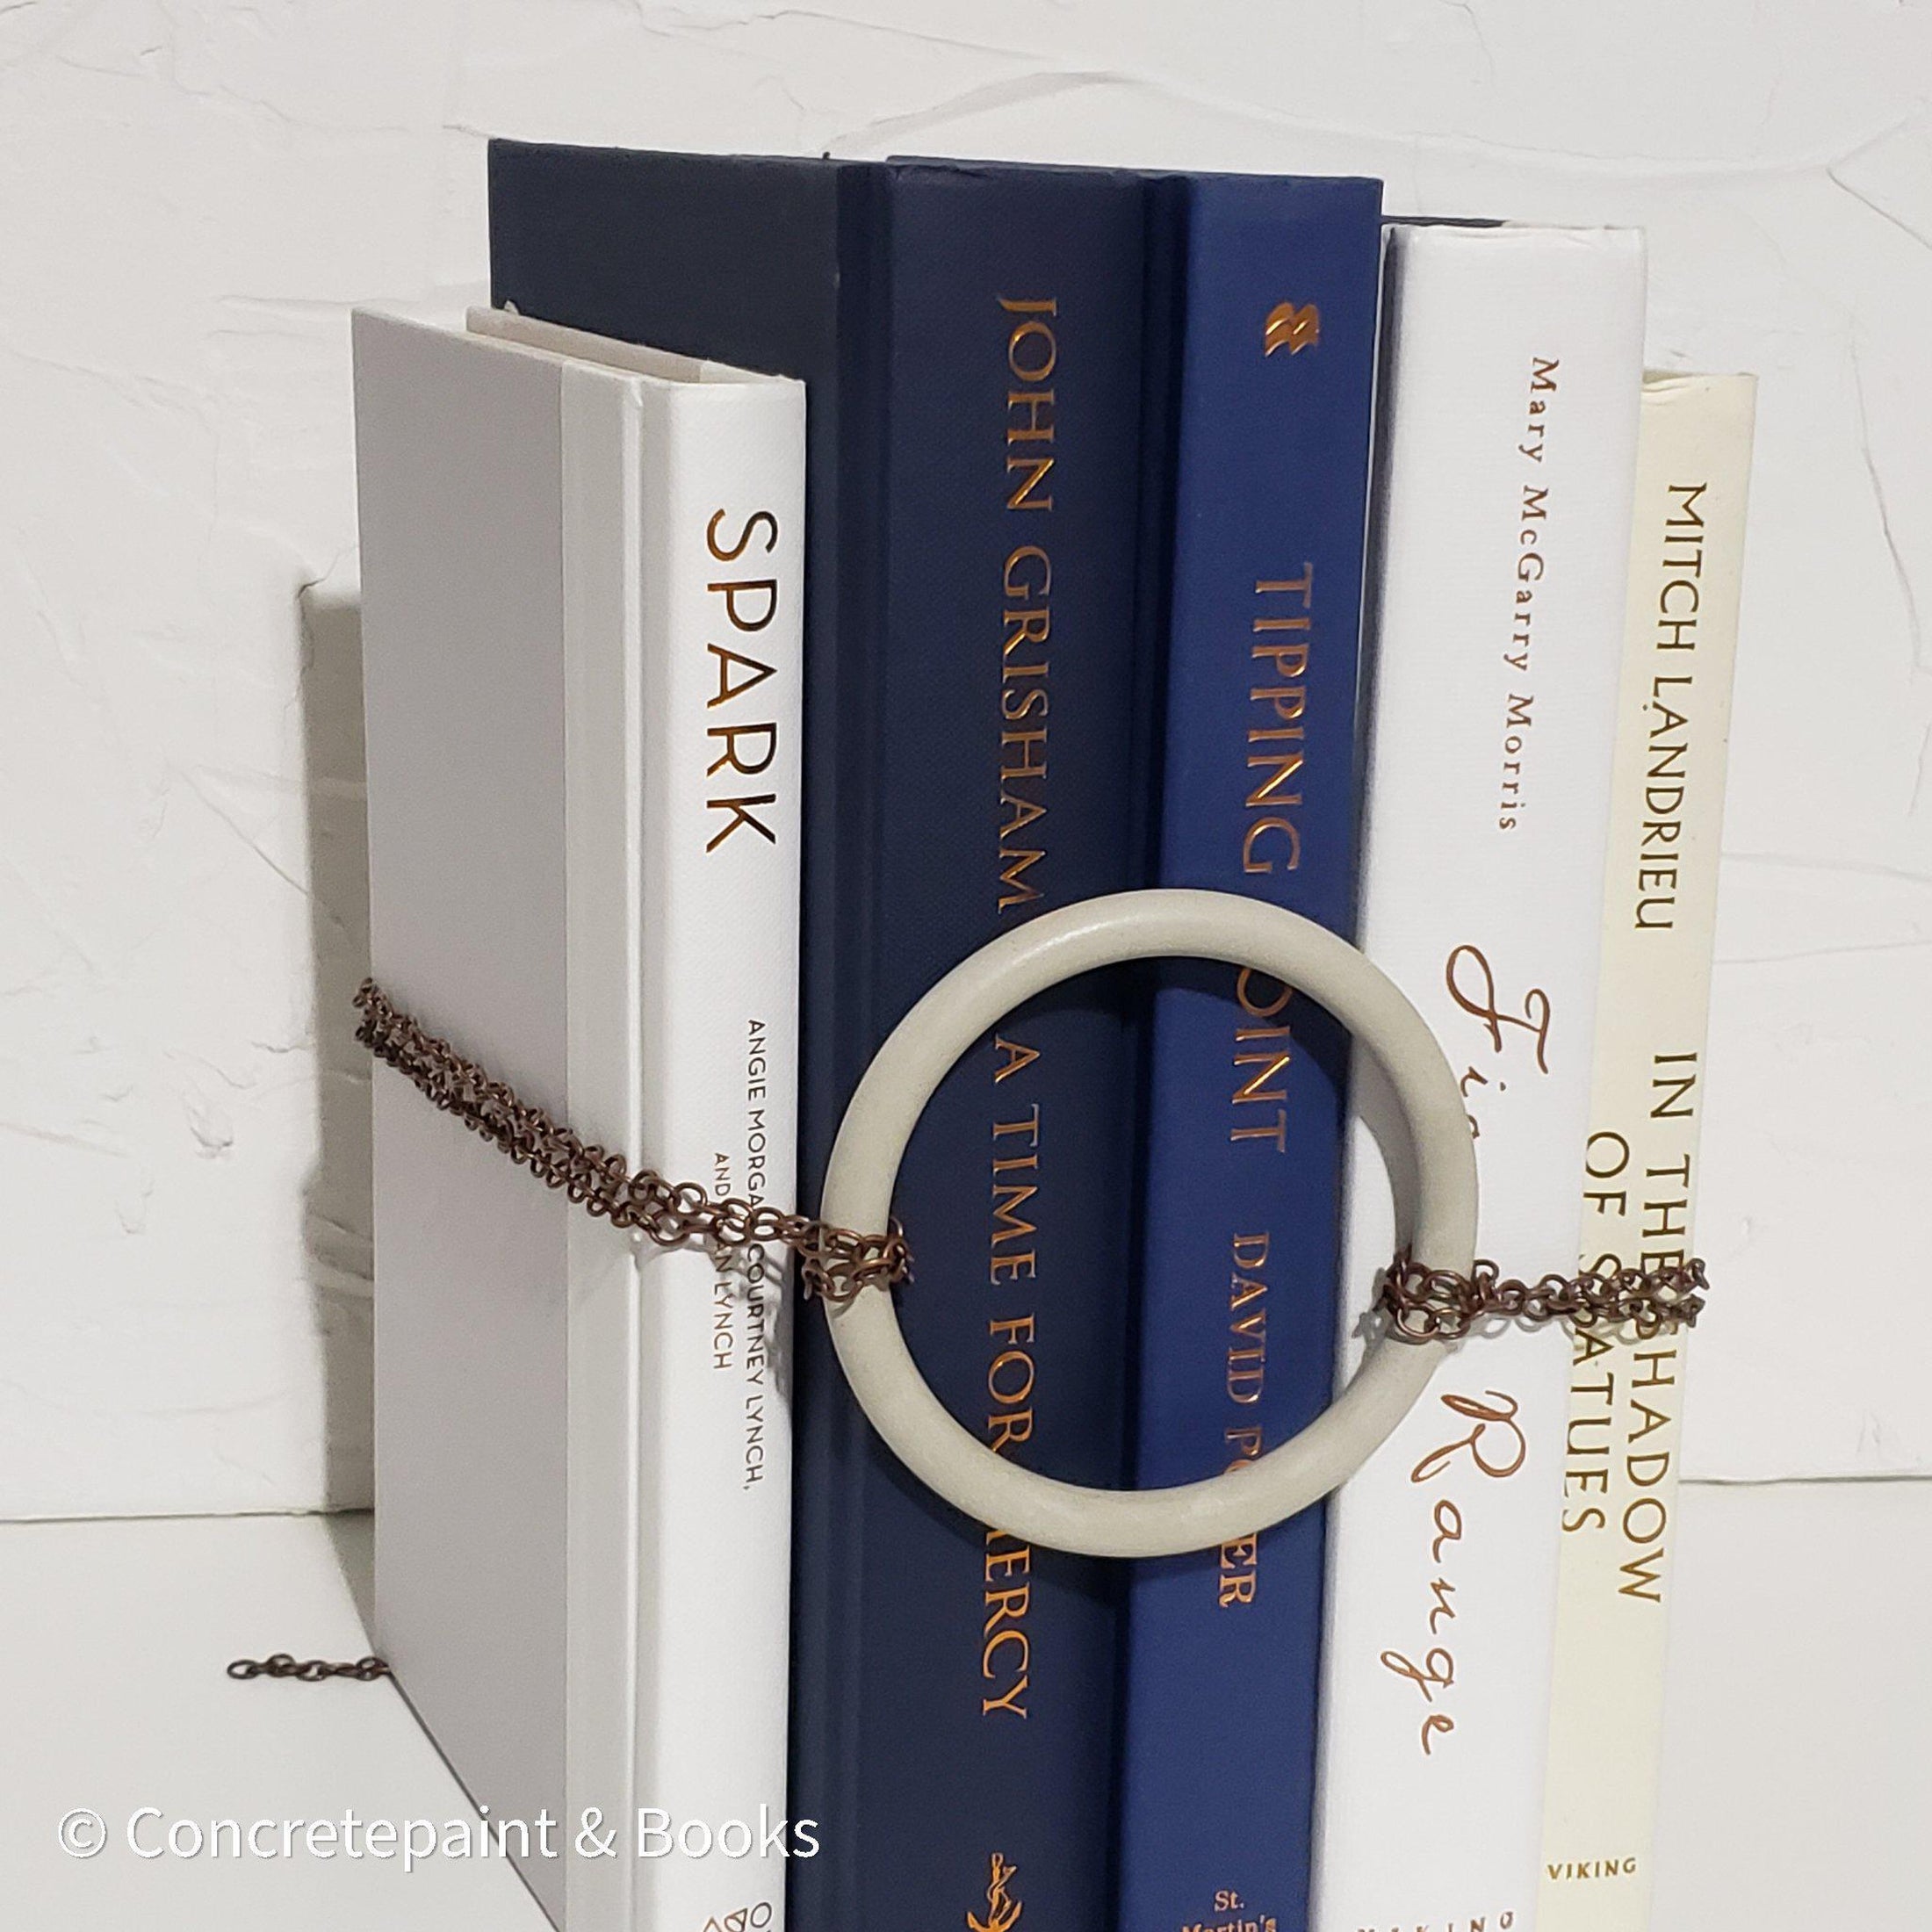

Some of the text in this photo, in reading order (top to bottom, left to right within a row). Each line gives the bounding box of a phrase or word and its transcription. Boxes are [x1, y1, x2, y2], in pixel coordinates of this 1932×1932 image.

[705, 508, 779, 854] SPARK
[996, 297, 1058, 914] JOHN GRISHAM
[1497, 357, 1560, 831] Mary McGarry Morris
[1633, 481, 1707, 929] MITCH LANDRIEU
[1229, 560, 1316, 1154] TIPPING OINT
[994, 1033, 1041, 1085] A
[1648, 1051, 1698, 1121] IN
[713, 1150, 732, 1198] AND
[743, 1019, 768, 1491] ANGIE MORGA COURTNEY LYNCH,
[989, 1101, 1040, 1287] TIME
[1582, 1130, 1631, 1217] OF
[712, 1280, 734, 1370] LYNCH
[987, 1312, 1035, 1453] FOR
[1227, 1231, 1271, 1405] DAVID
[1614, 1314, 1678, 1605] HADOW
[1379, 1388, 1526, 1755] Range
[1214, 1890, 1245, 1912] St.
[1546, 1856, 1637, 1880] VIKING
